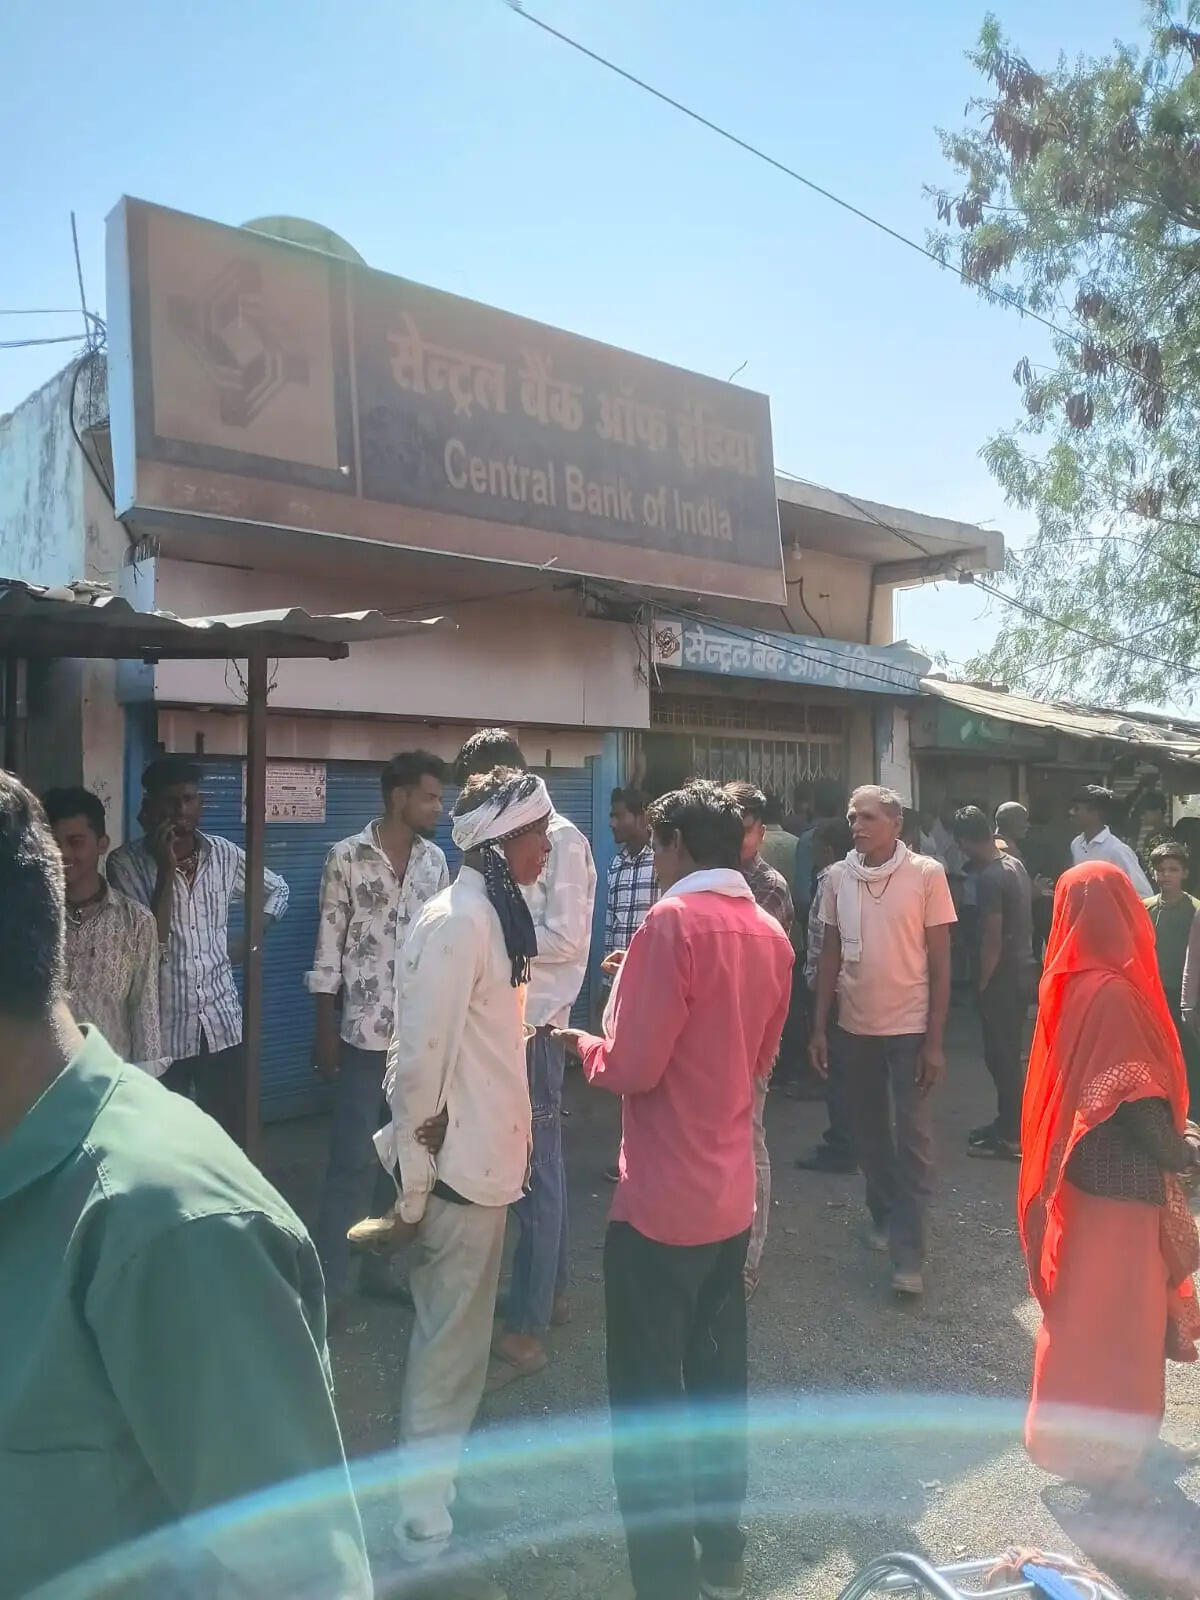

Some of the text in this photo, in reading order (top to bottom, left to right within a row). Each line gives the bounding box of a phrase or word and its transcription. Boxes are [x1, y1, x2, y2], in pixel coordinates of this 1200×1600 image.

[519, 348, 583, 432] बैंक
[444, 438, 733, 543] Central Bank of India
